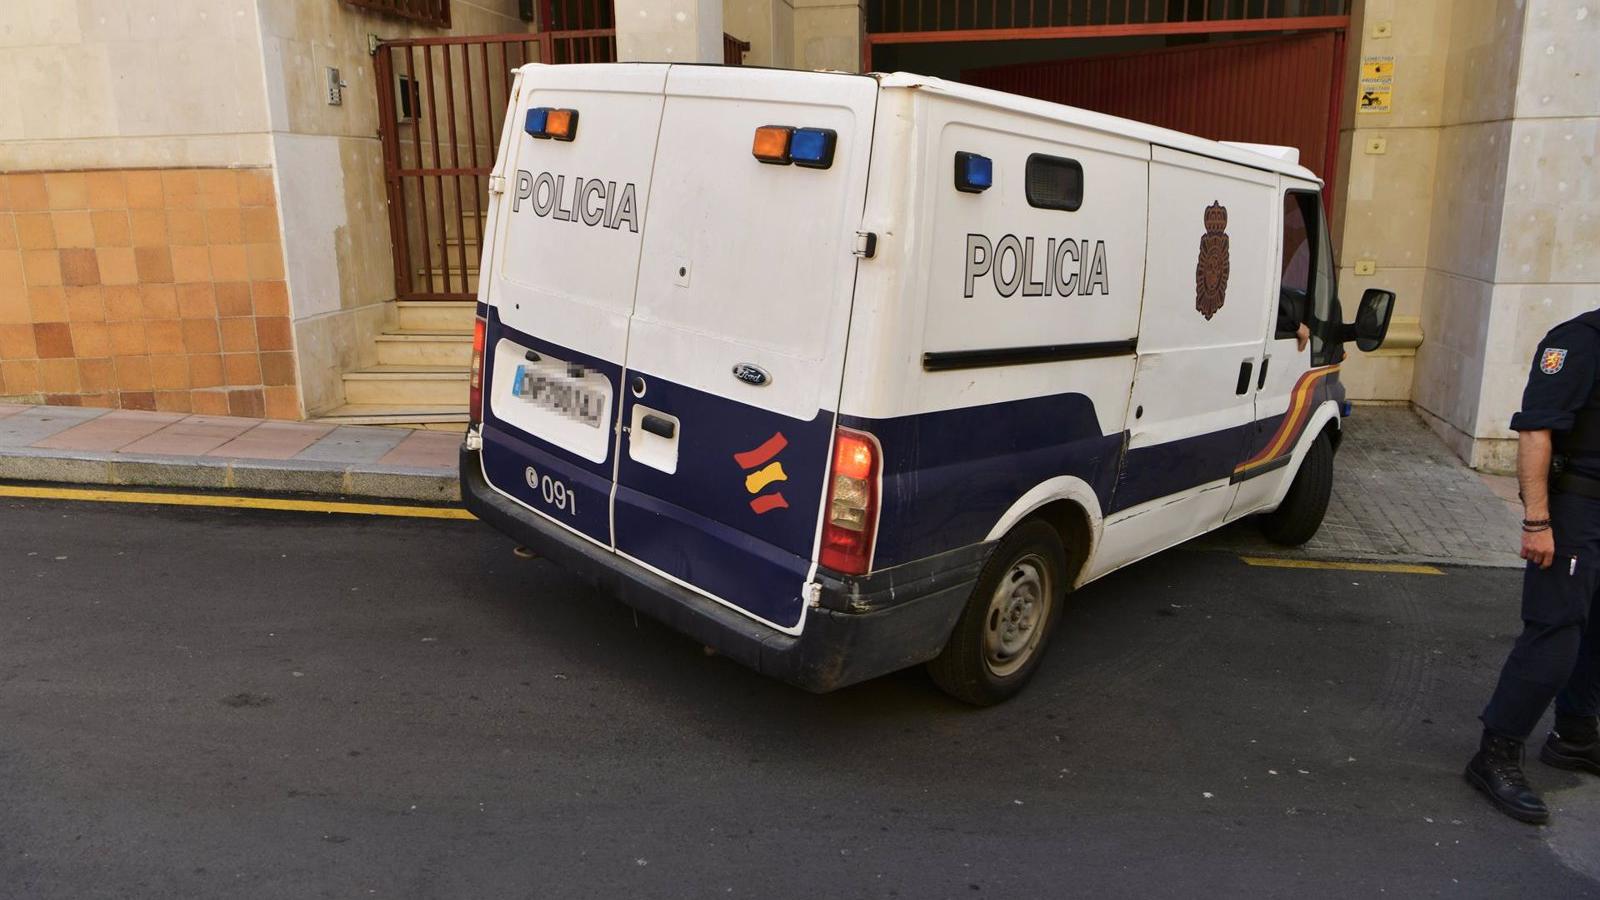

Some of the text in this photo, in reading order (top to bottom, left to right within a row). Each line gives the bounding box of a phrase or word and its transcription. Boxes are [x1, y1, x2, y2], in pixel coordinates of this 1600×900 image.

[513, 169, 639, 233] POLICIA
[964, 233, 1109, 298] POLICIA
[542, 475, 576, 515] 091
